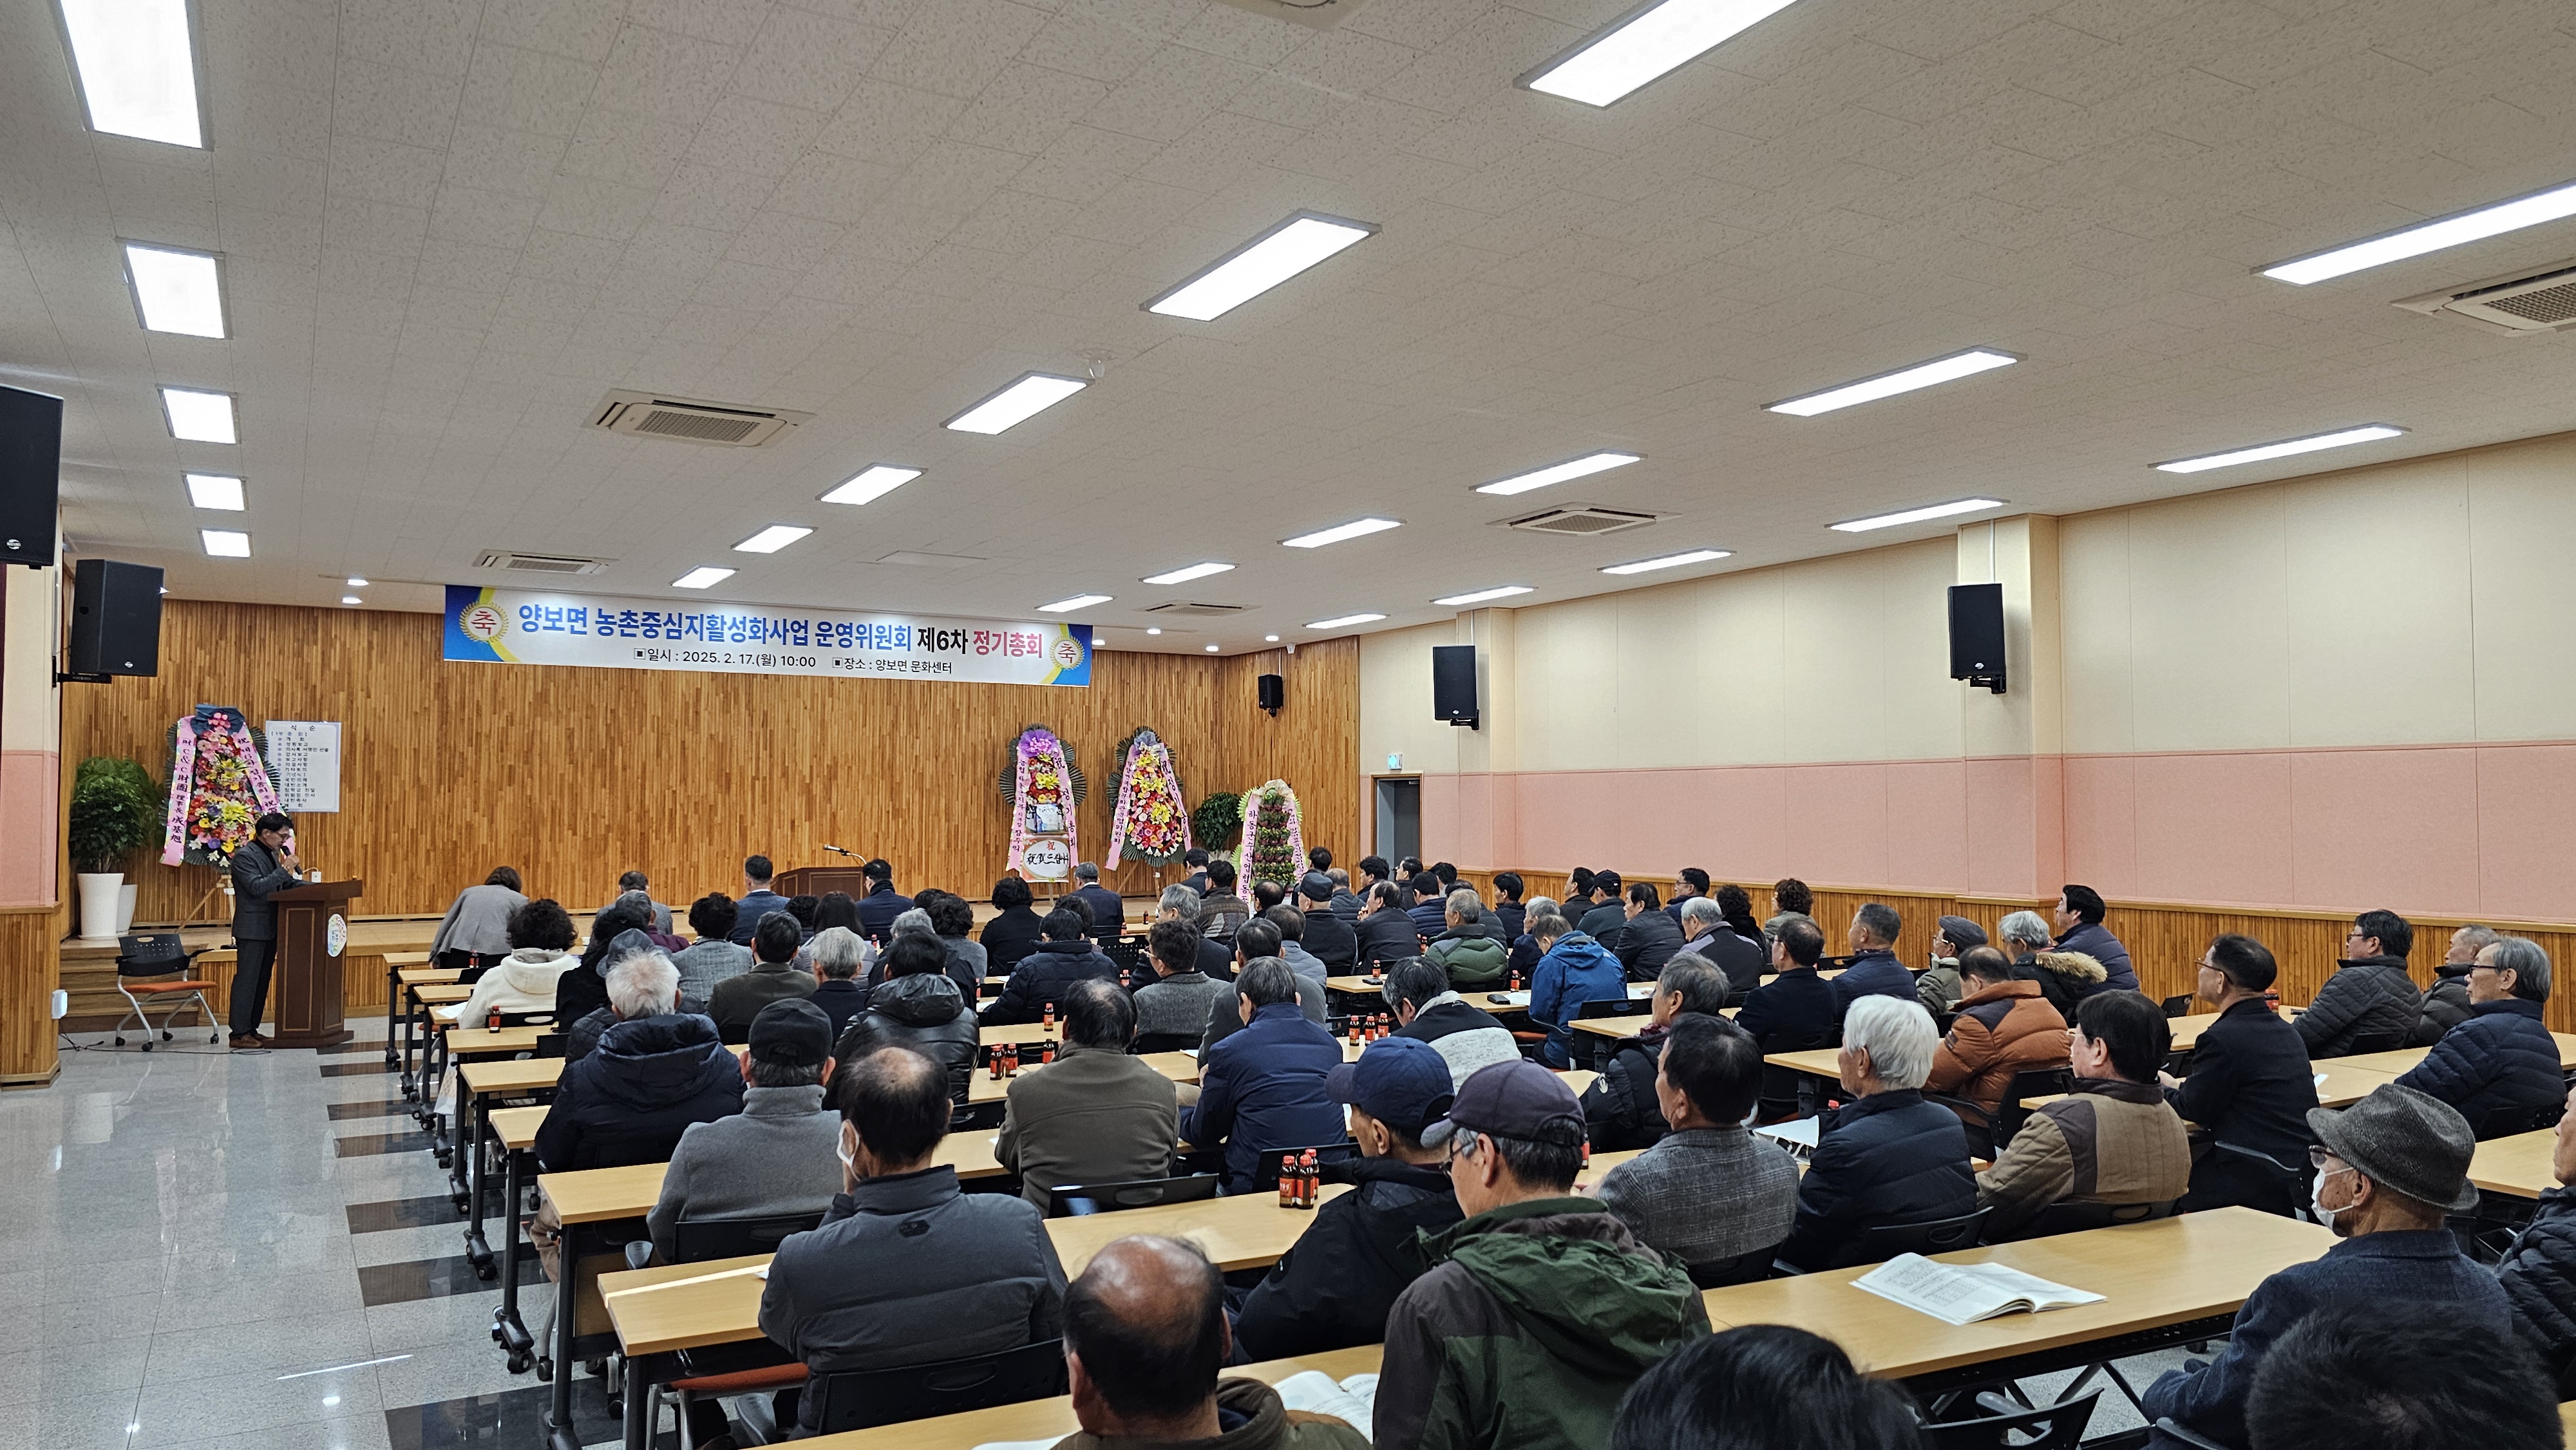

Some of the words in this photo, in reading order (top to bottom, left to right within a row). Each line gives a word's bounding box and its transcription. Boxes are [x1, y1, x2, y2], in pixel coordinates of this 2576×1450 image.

[471, 610, 497, 636] 축
[519, 605, 589, 636] 양보면
[595, 608, 809, 646] 농촌중심지활성화사업
[815, 621, 912, 651] 운영위원회
[917, 628, 968, 654] 제6차
[973, 630, 1043, 658] 정기총회
[648, 648, 672, 663] 일시
[683, 651, 721, 663] 2025.
[724, 653, 735, 664] 2.
[739, 653, 777, 667] 17.(월)
[782, 657, 816, 667] 10:00
[1058, 644, 1077, 664] 축
[844, 658, 866, 670] 장소
[876, 659, 907, 672] 양보면
[911, 661, 952, 674] 문화센터
